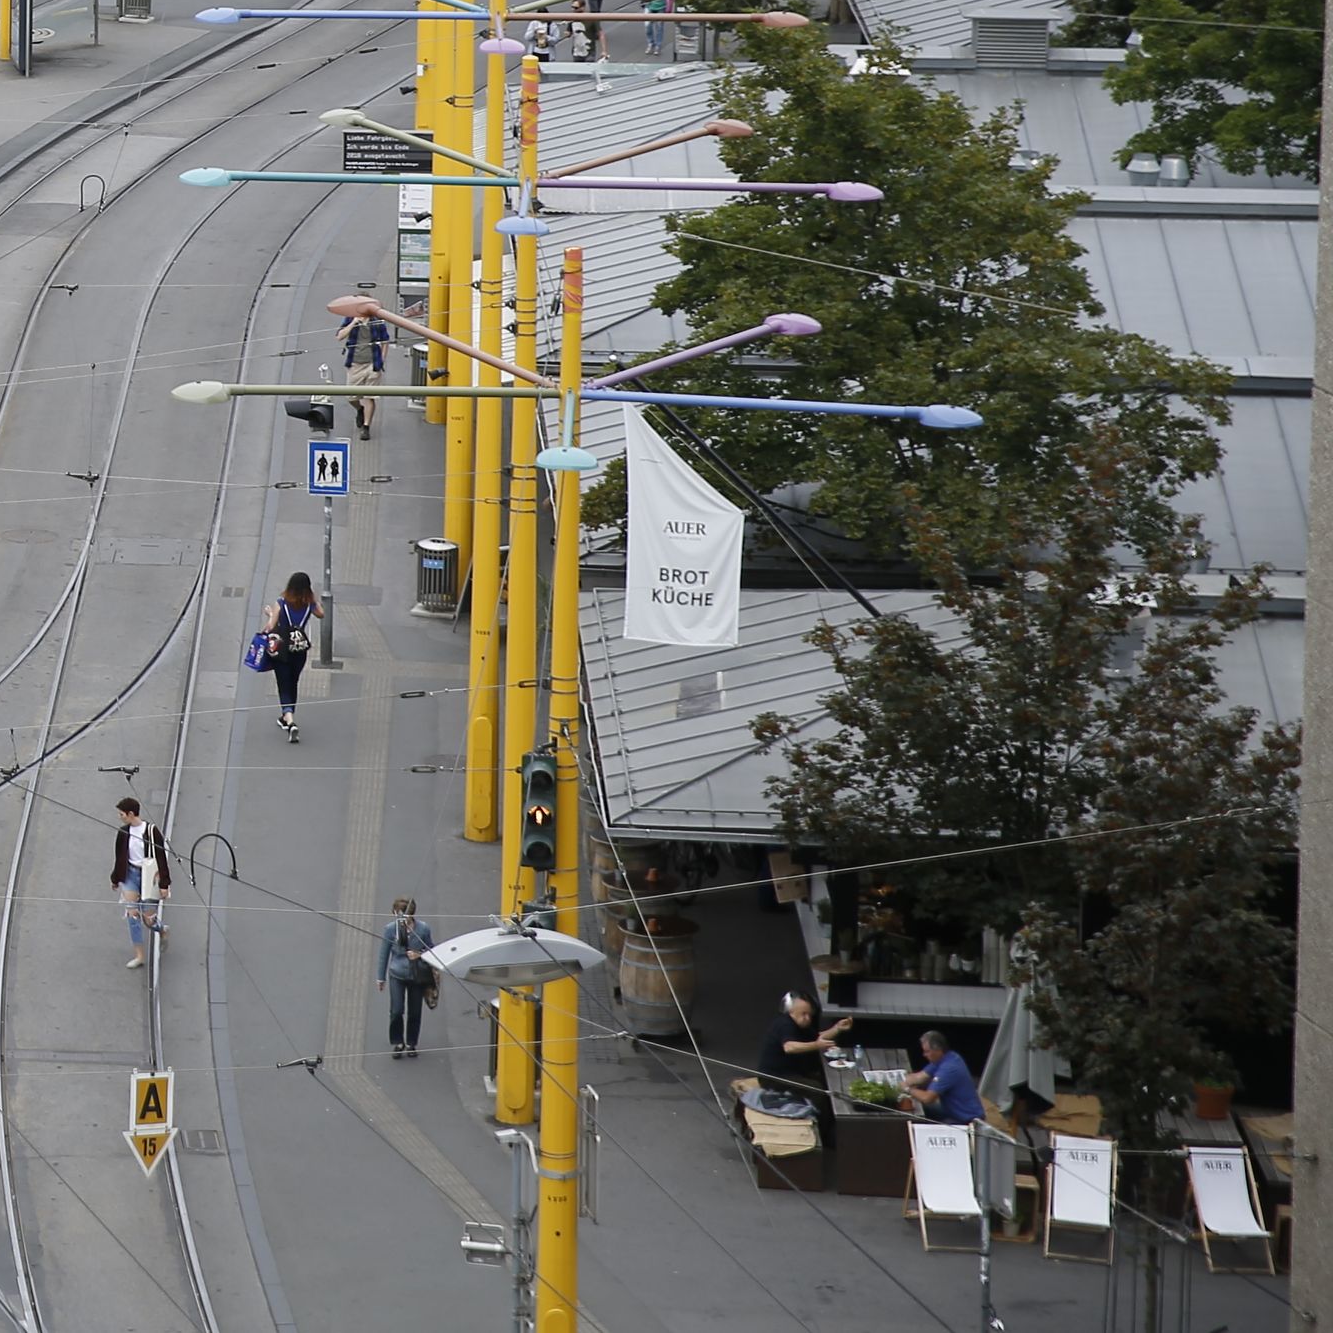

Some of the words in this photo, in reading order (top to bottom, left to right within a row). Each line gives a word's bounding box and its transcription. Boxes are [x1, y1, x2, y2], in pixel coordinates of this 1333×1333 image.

[662, 520, 707, 536] AUER
[659, 567, 709, 585] BROT
[651, 585, 715, 607] KÜCHE
[139, 1082, 164, 1120] A
[141, 1137, 157, 1157] 15
[927, 1136, 958, 1147] AUER
[1068, 1150, 1098, 1163] AUER
[1203, 1160, 1233, 1171] AUER
